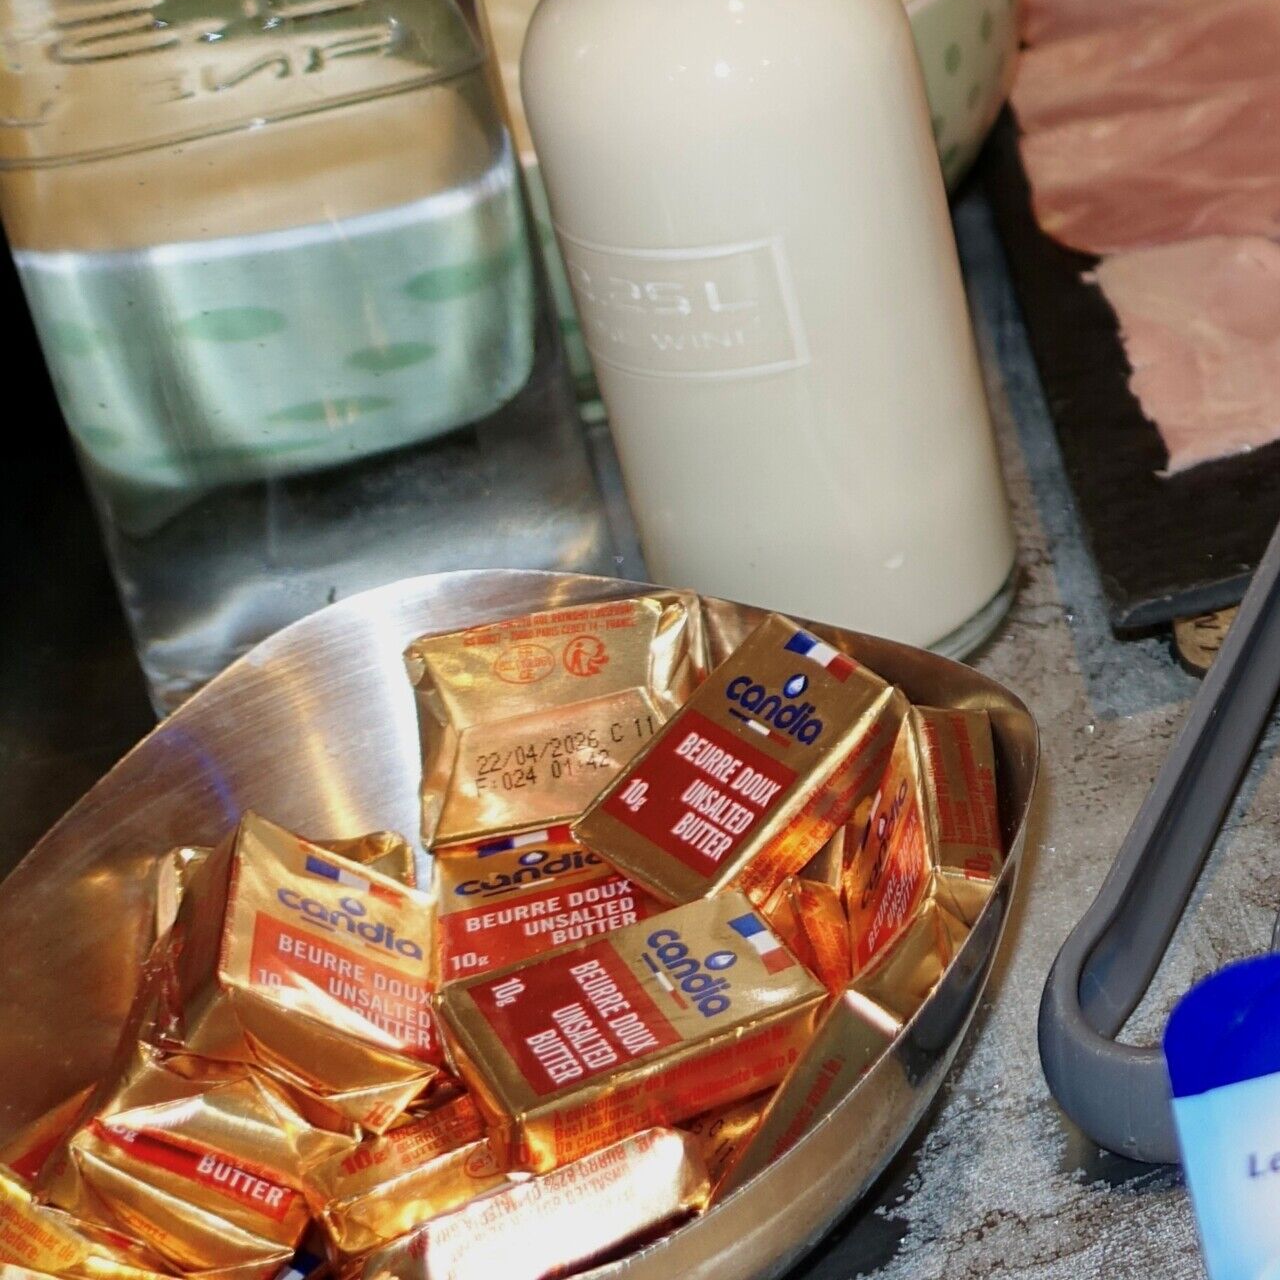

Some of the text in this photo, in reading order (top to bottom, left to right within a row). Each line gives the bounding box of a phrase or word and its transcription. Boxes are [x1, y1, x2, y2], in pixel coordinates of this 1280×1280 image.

[726, 676, 823, 746] candia
[476, 729, 600, 775] 22/04/2026
[675, 733, 781, 807] BEURRE DOUX
[619, 778, 649, 812] 10g
[682, 779, 754, 835] UNSALTED
[670, 812, 733, 862] BUTTER
[277, 887, 423, 960] candia
[466, 880, 632, 932] BEURRE DOUX
[524, 897, 634, 936] UNSALTED
[552, 912, 637, 945] BUTTER
[279, 933, 431, 1004] BEURRE DOUX
[450, 952, 490, 970] 10g
[646, 929, 730, 1018] candia
[329, 977, 431, 1028] UNSALTED
[491, 977, 526, 1008] 10g
[570, 959, 659, 1055] BEURRE DOUX
[526, 1029, 584, 1085] BUTTER
[551, 1003, 618, 1070] UNSALTED
[196, 1154, 291, 1208] BUTTER
